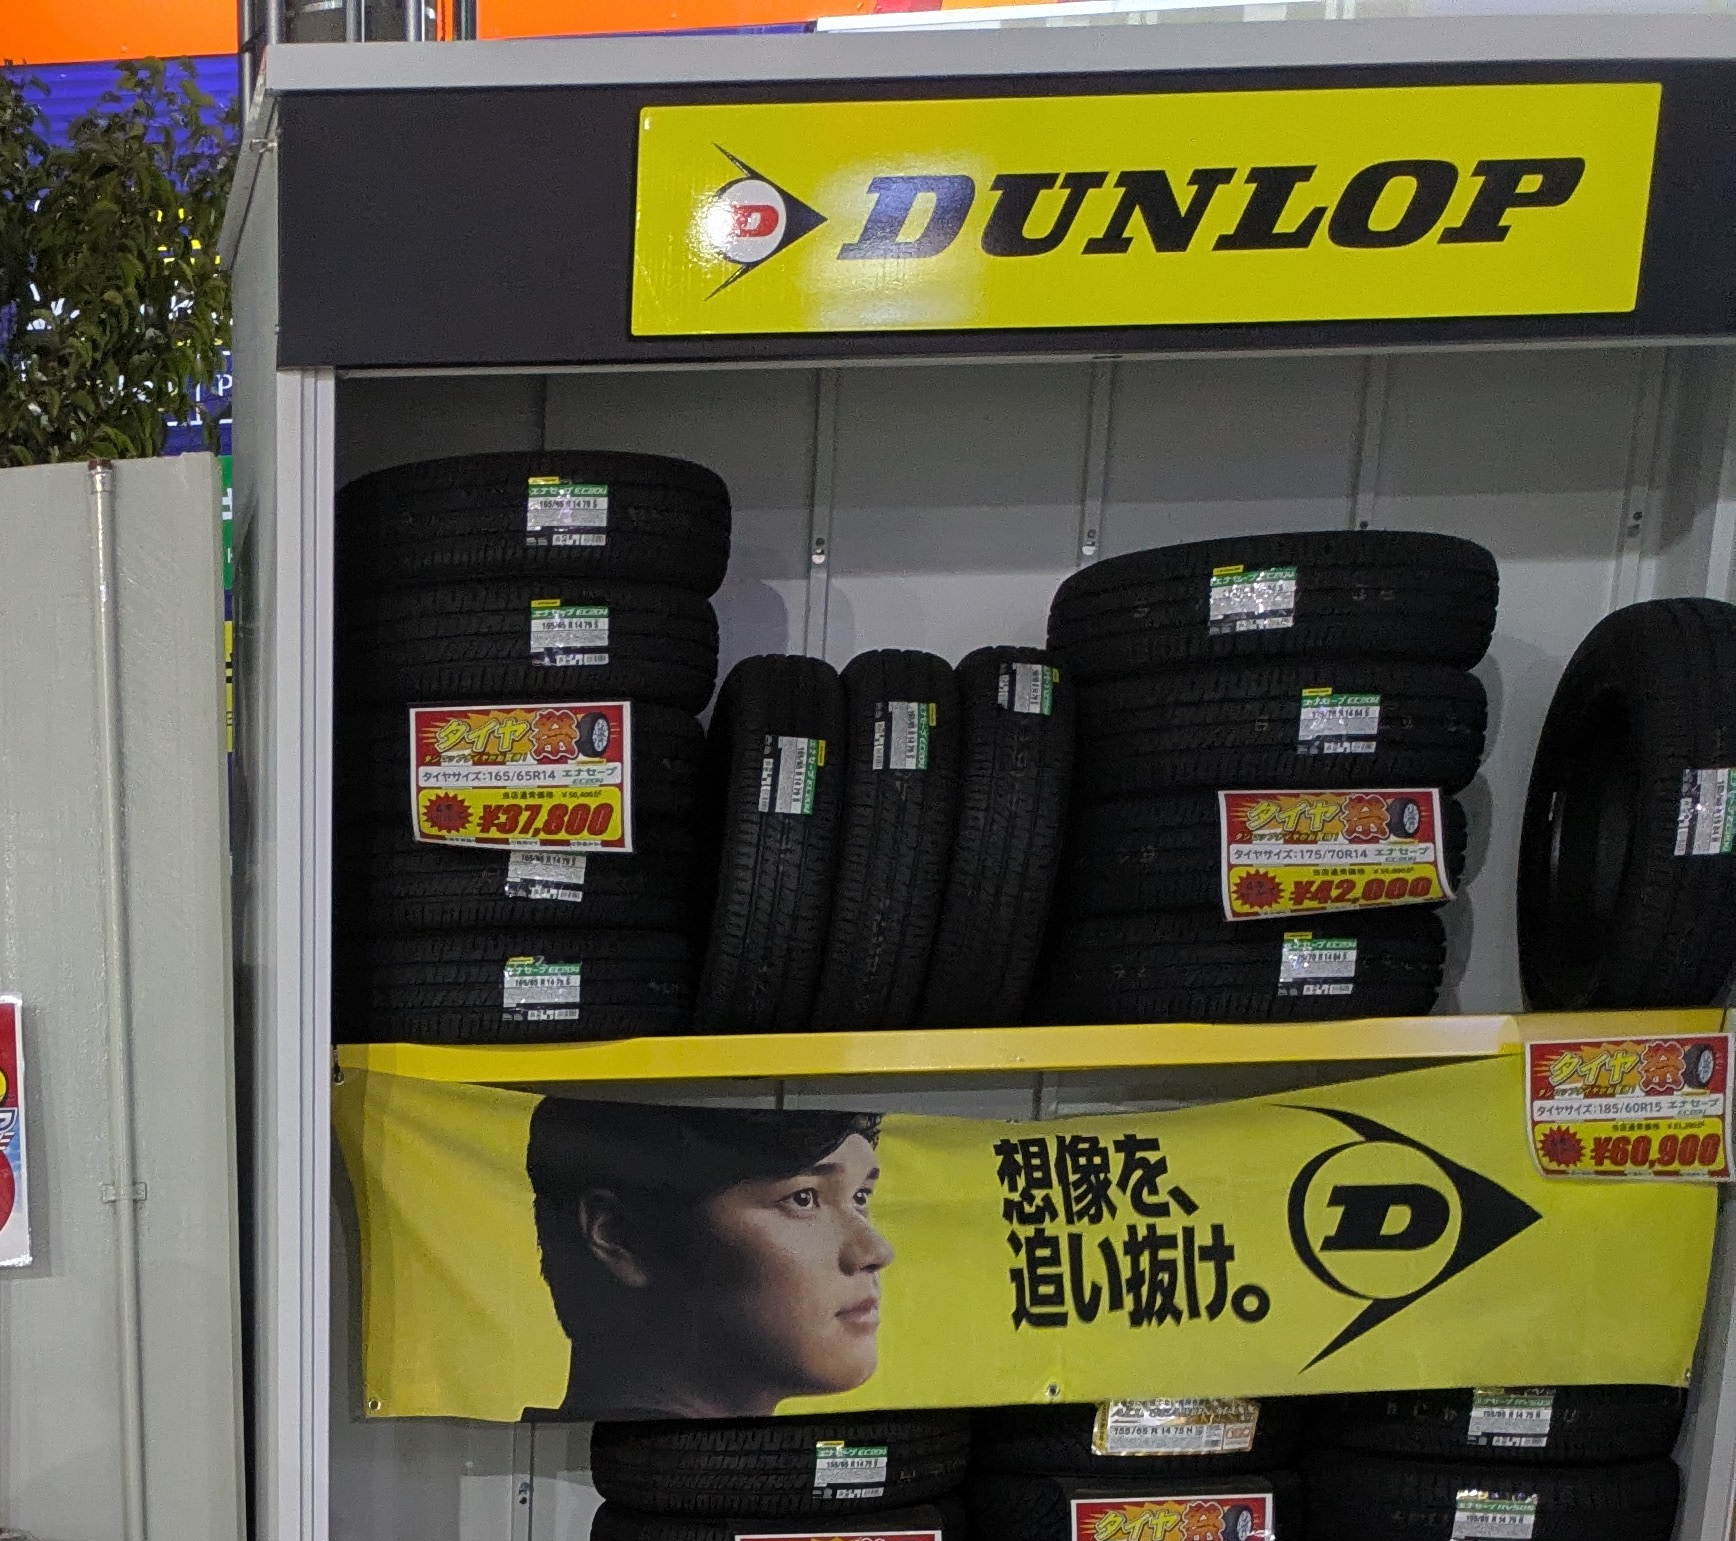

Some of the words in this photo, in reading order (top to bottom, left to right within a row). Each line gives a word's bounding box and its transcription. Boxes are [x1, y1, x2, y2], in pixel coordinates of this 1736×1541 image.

[836, 156, 1587, 262] DUNLOP
[435, 709, 579, 759] タイヤ祭
[477, 803, 614, 837] ¥37,800
[1246, 793, 1390, 840] タイヤ祭
[1289, 876, 1432, 906] ¥42,000
[1549, 1041, 1686, 1091] タイヤ祭
[1590, 1133, 1721, 1169] ¥60,900
[993, 1134, 1200, 1228] 想像を、
[1320, 1182, 1451, 1252] D
[1008, 1224, 1271, 1331] 追い抜け。
